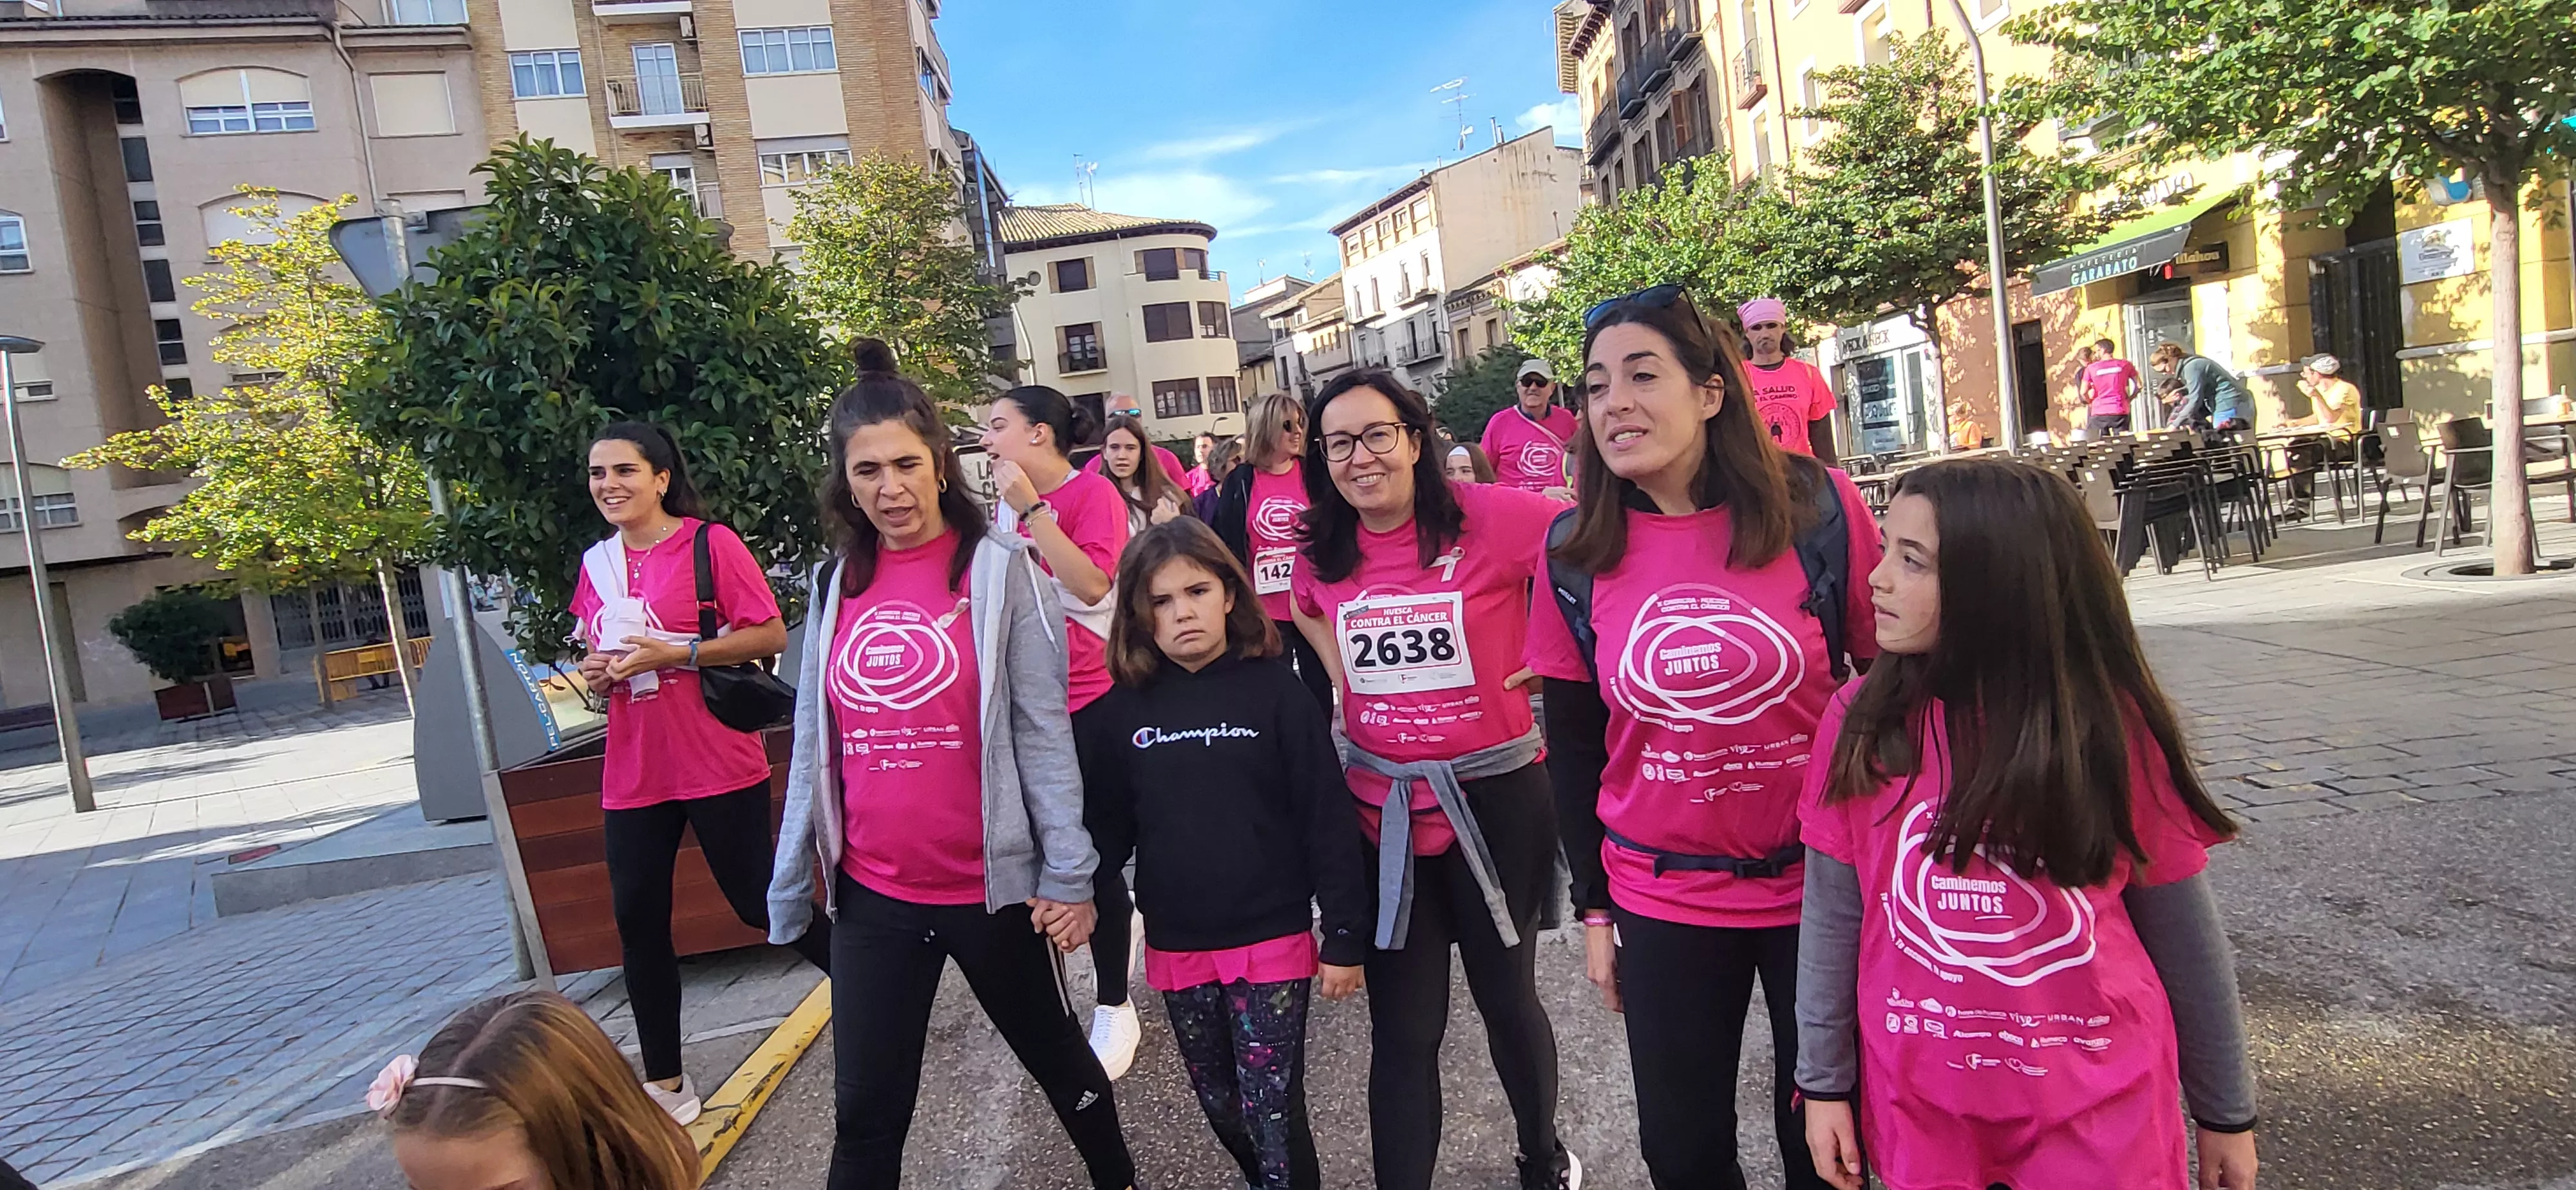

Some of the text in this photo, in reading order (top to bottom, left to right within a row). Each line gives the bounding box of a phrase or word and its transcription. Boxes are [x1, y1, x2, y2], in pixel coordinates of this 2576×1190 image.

[2070, 256, 2137, 285] GARABATO
[1762, 386, 1795, 395] SALUD
[1350, 612, 1448, 628] CONTRA EL CÁNCER
[1383, 607, 1413, 616] HUESCA
[1350, 627, 1455, 668] 2638
[866, 654, 902, 667] JUNTOS
[1664, 654, 1719, 675] JUNTOS
[509, 652, 559, 750] PEL-CARTÓN
[1132, 722, 1260, 749] Champion
[1931, 874, 2007, 894] Caminemos
[1937, 892, 2004, 914] JUNTOS
[2047, 1014, 2085, 1026] URBAN
